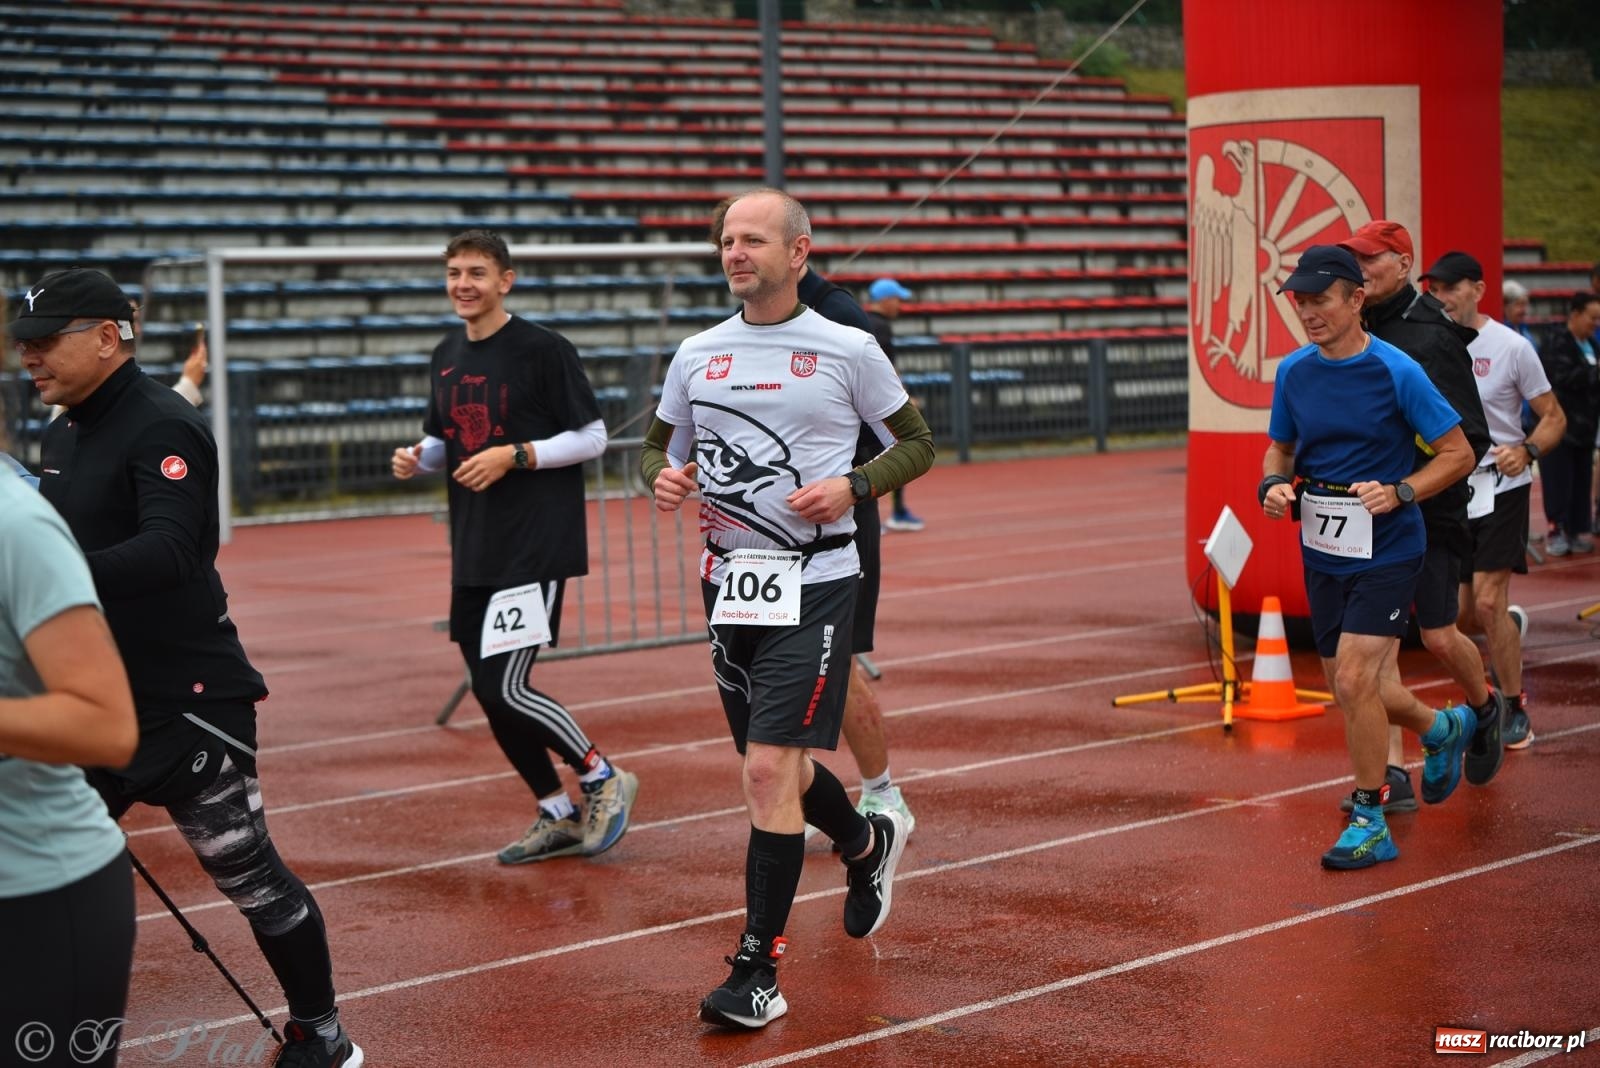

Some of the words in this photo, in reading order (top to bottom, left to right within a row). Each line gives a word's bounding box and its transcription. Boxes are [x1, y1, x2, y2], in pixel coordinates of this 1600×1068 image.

[1315, 513, 1348, 538] 77
[723, 571, 782, 603] 106
[493, 607, 526, 633] 42
[721, 610, 759, 619] Racibórz
